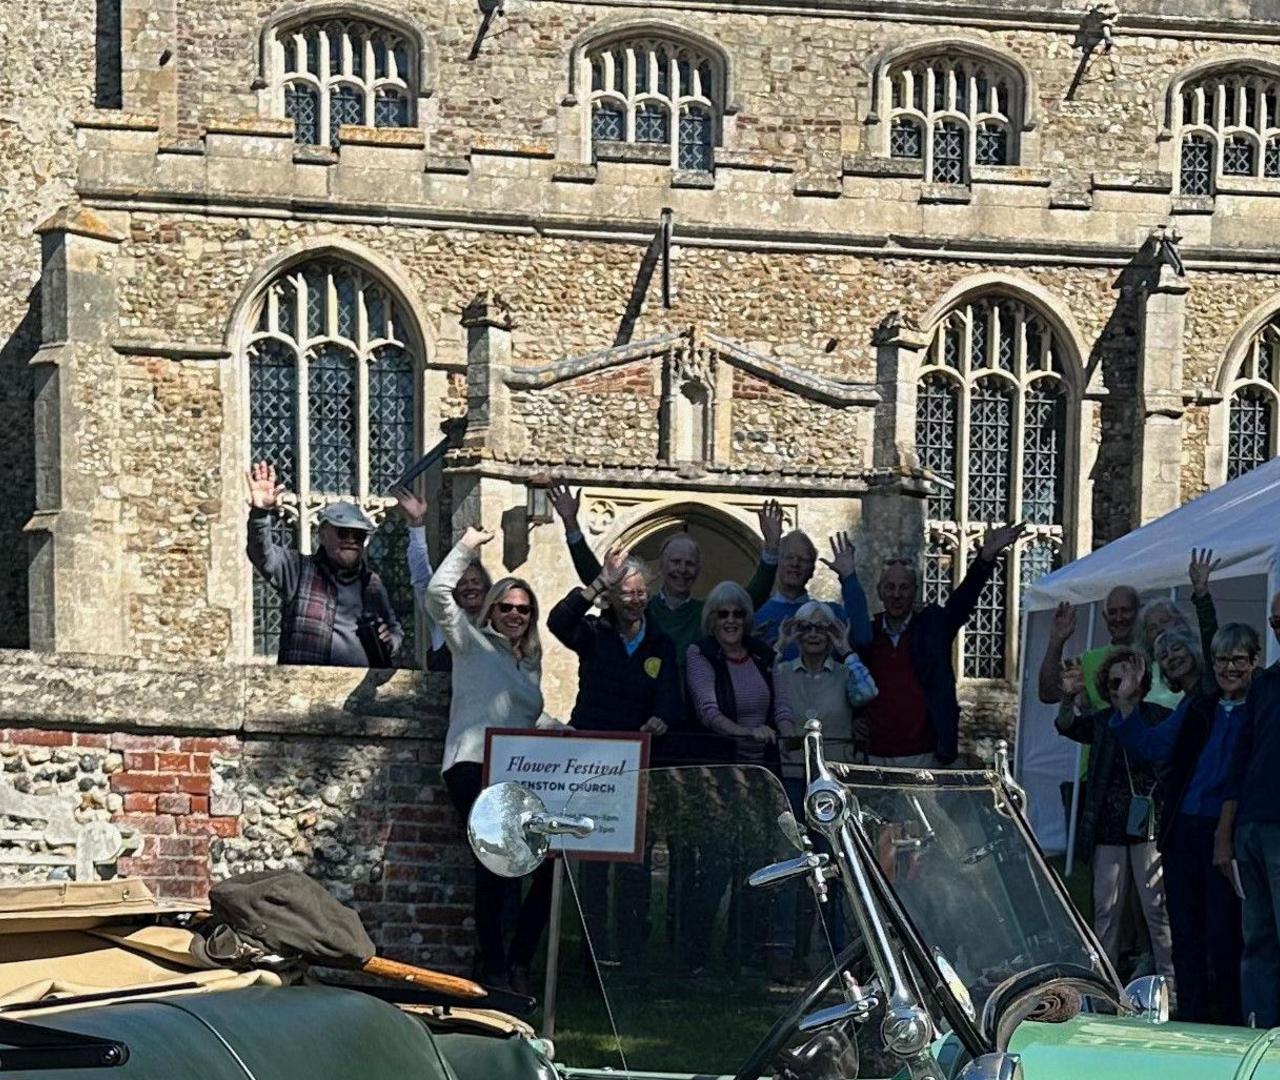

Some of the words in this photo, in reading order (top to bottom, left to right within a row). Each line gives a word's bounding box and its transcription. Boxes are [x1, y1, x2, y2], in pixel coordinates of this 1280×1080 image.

[507, 756, 560, 773] Flower
[565, 759, 627, 776] Festival
[569, 782, 616, 794] CHURCH
